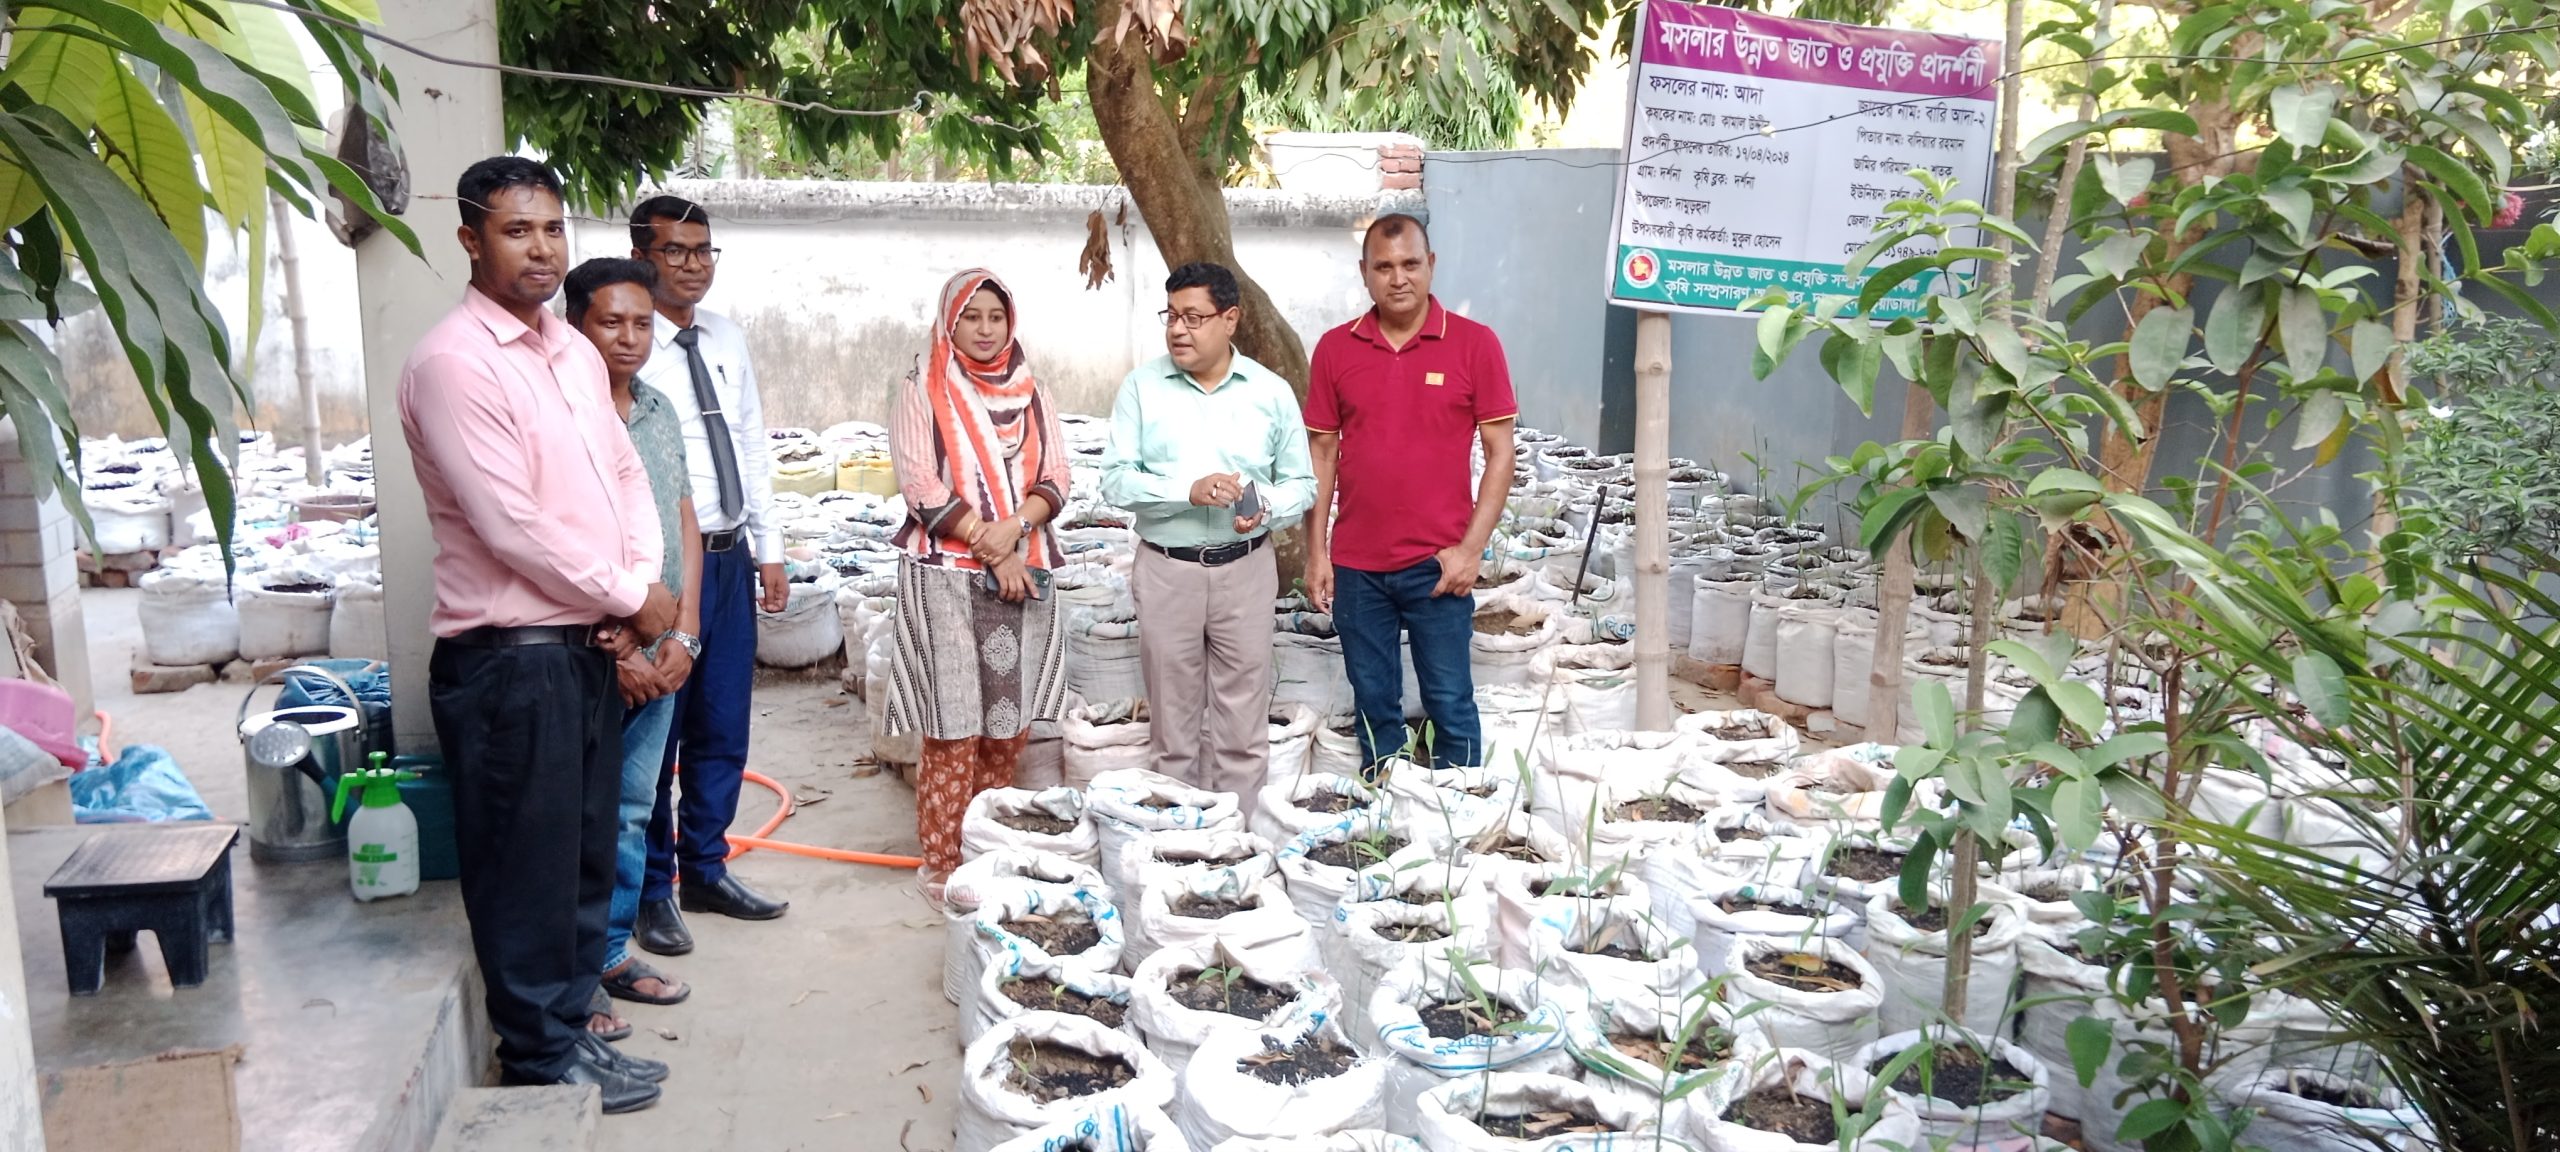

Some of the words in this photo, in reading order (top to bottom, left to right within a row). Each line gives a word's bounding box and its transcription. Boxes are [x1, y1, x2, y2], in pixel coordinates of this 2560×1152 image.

[1659, 21, 1729, 59] মসলার
[1733, 19, 1783, 70] উন্নত
[1787, 37, 1833, 70] জাত
[1838, 47, 1853, 71] ও
[1859, 40, 1916, 86] প্রযুক্তি
[1920, 45, 1986, 87] প্রদর্শনী
[1649, 76, 1697, 97] ফসলের
[1735, 85, 1764, 105] আদা
[1925, 101, 1948, 121] বারি
[1857, 126, 1883, 145] পিতার
[1938, 137, 1965, 152] রহমান
[1660, 164, 1682, 181] দর্শনা
[1693, 167, 1710, 189] কৃষি
[1734, 171, 1756, 189] দর্শনা
[1853, 155, 1877, 172] জমির
[1677, 223, 1694, 244] কৃষি
[1731, 232, 1752, 249] মুকুল
[1754, 234, 1782, 249] হোসেন
[1667, 258, 1710, 276] মসলার
[1713, 259, 1744, 281] উন্নত
[1747, 266, 1775, 282] জাত
[1778, 270, 1788, 282] ও
[1792, 268, 1829, 289] প্রযুক্তি
[1664, 277, 1690, 300] কৃষি
[1693, 282, 1750, 301] সম্প্রসারণ
